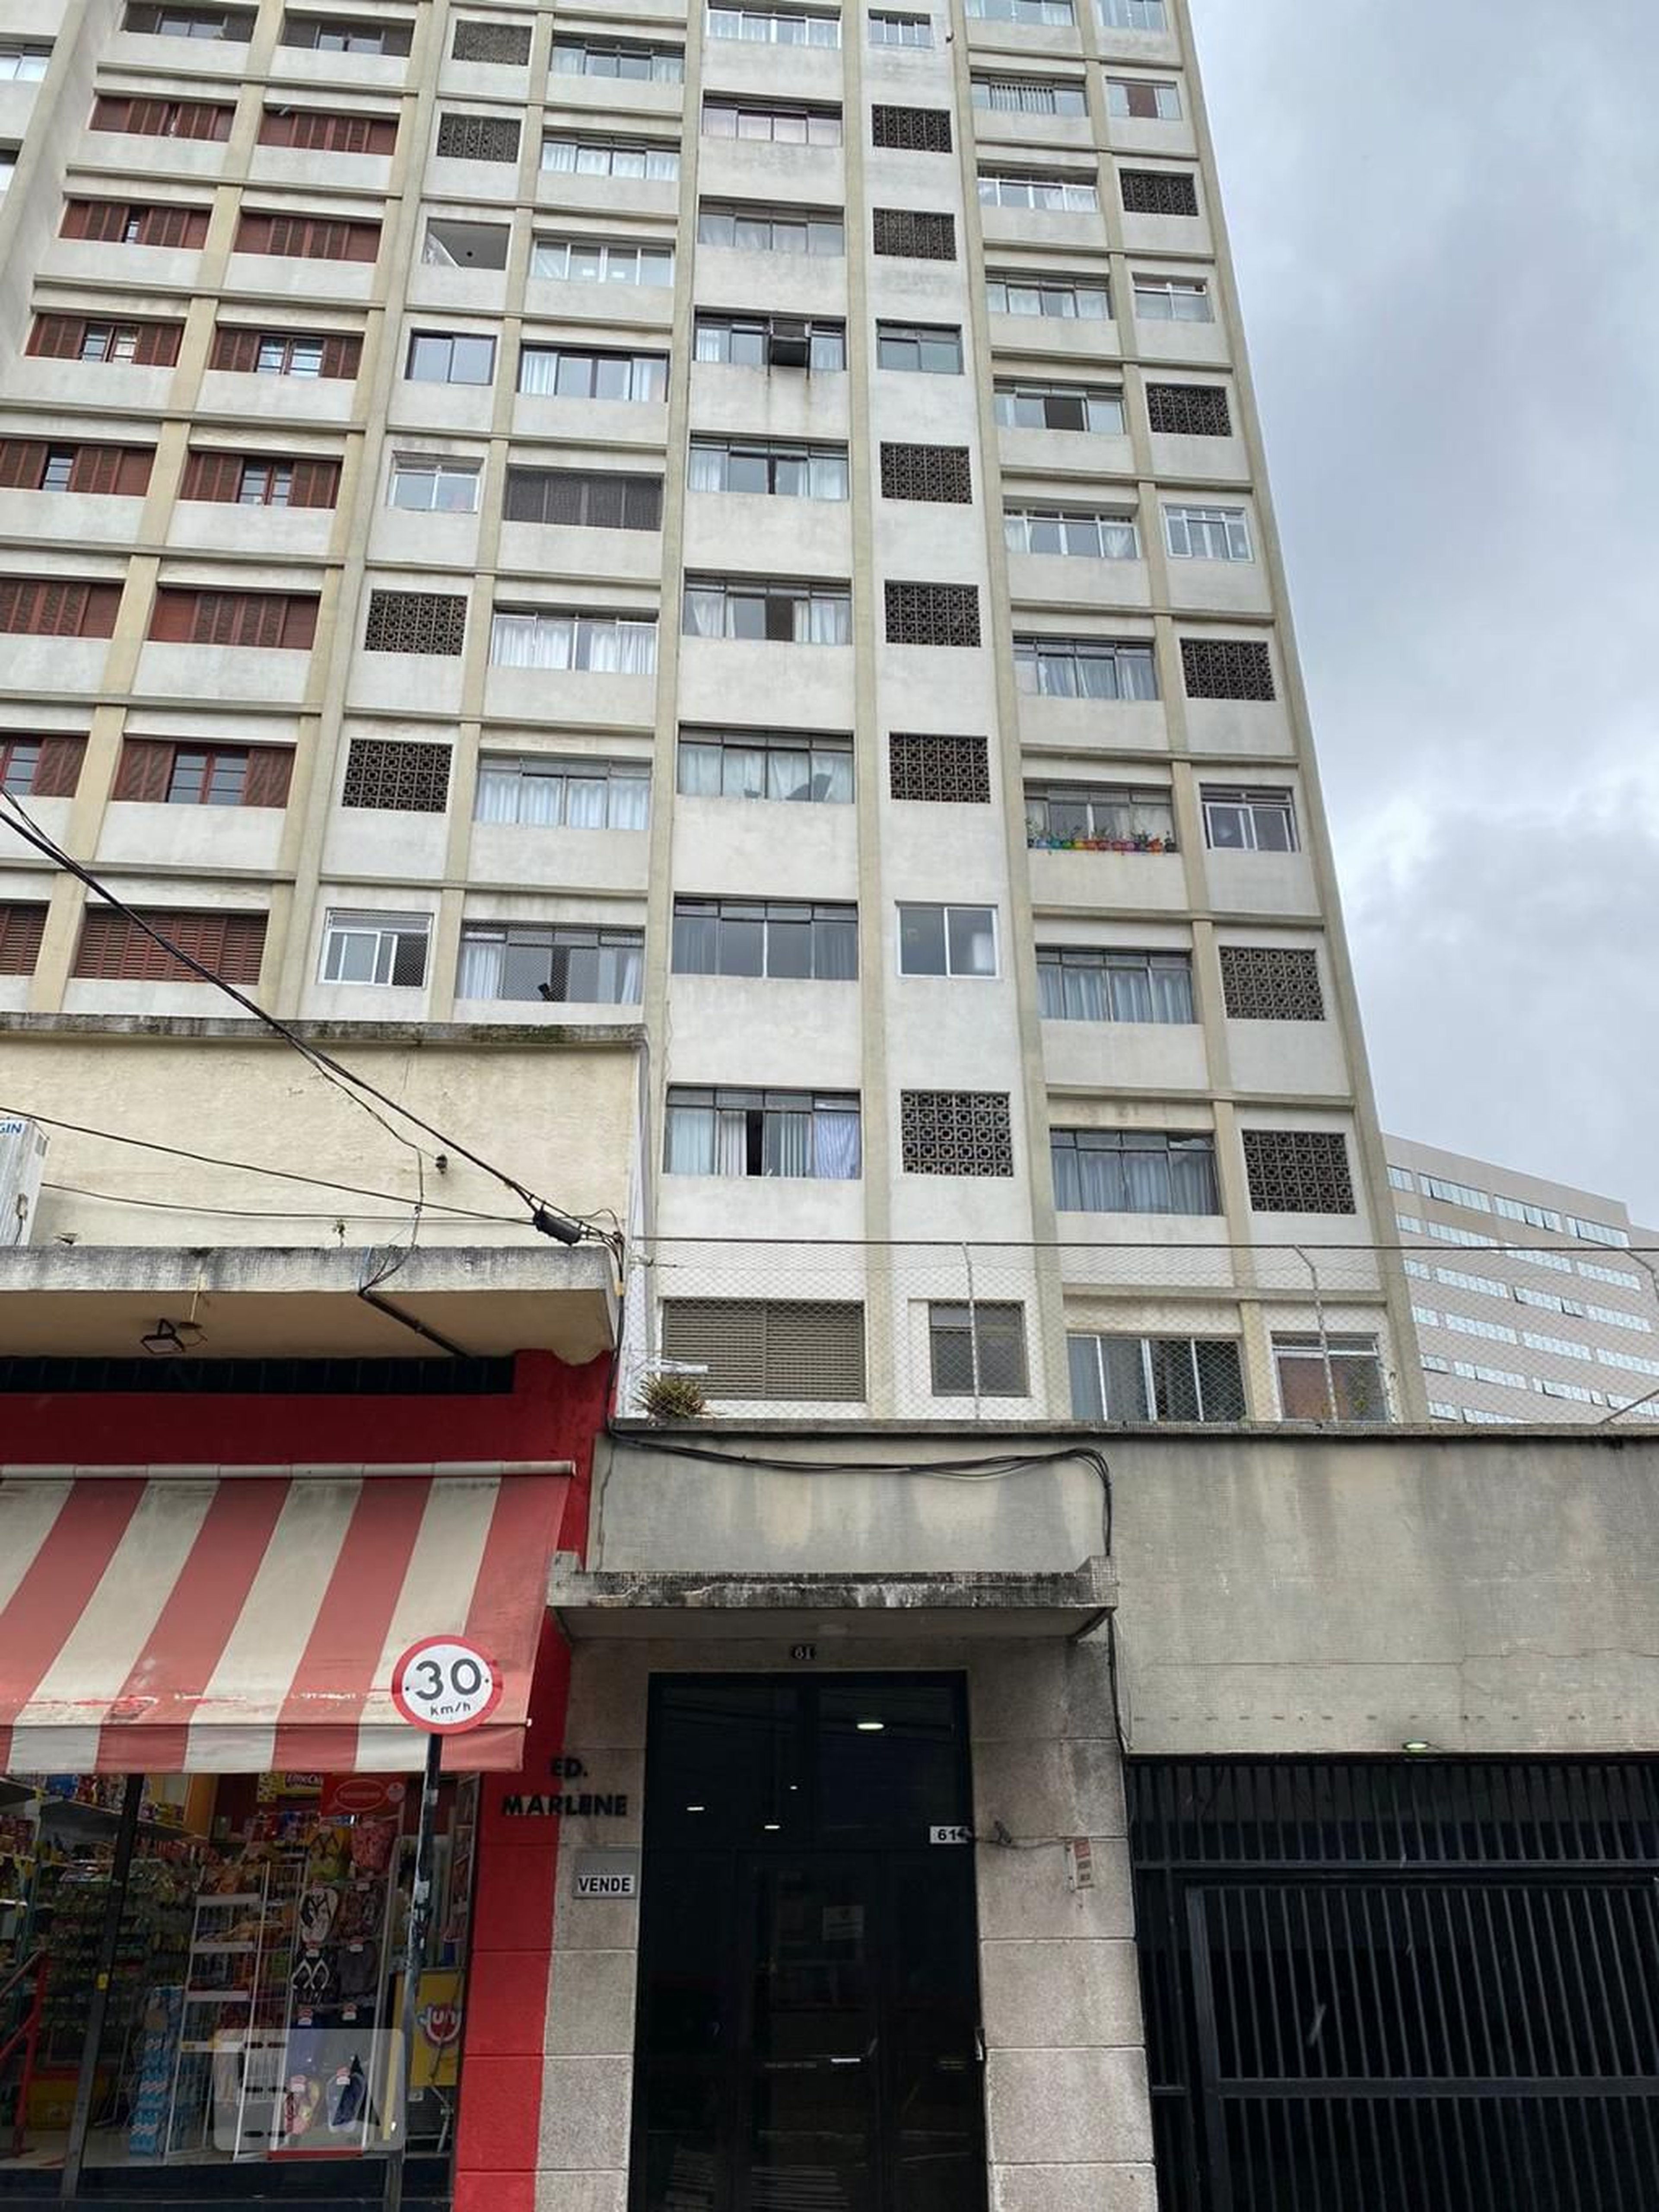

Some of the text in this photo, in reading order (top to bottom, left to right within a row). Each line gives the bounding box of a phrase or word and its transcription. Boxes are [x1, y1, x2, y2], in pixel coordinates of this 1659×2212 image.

[795, 1646, 811, 1660] 61
[416, 1658, 481, 1700] 30
[431, 1702, 470, 1715] km/h
[552, 1758, 588, 1777] ED.
[503, 1795, 627, 1816] MARLENE
[578, 1878, 631, 1891] VENDE
